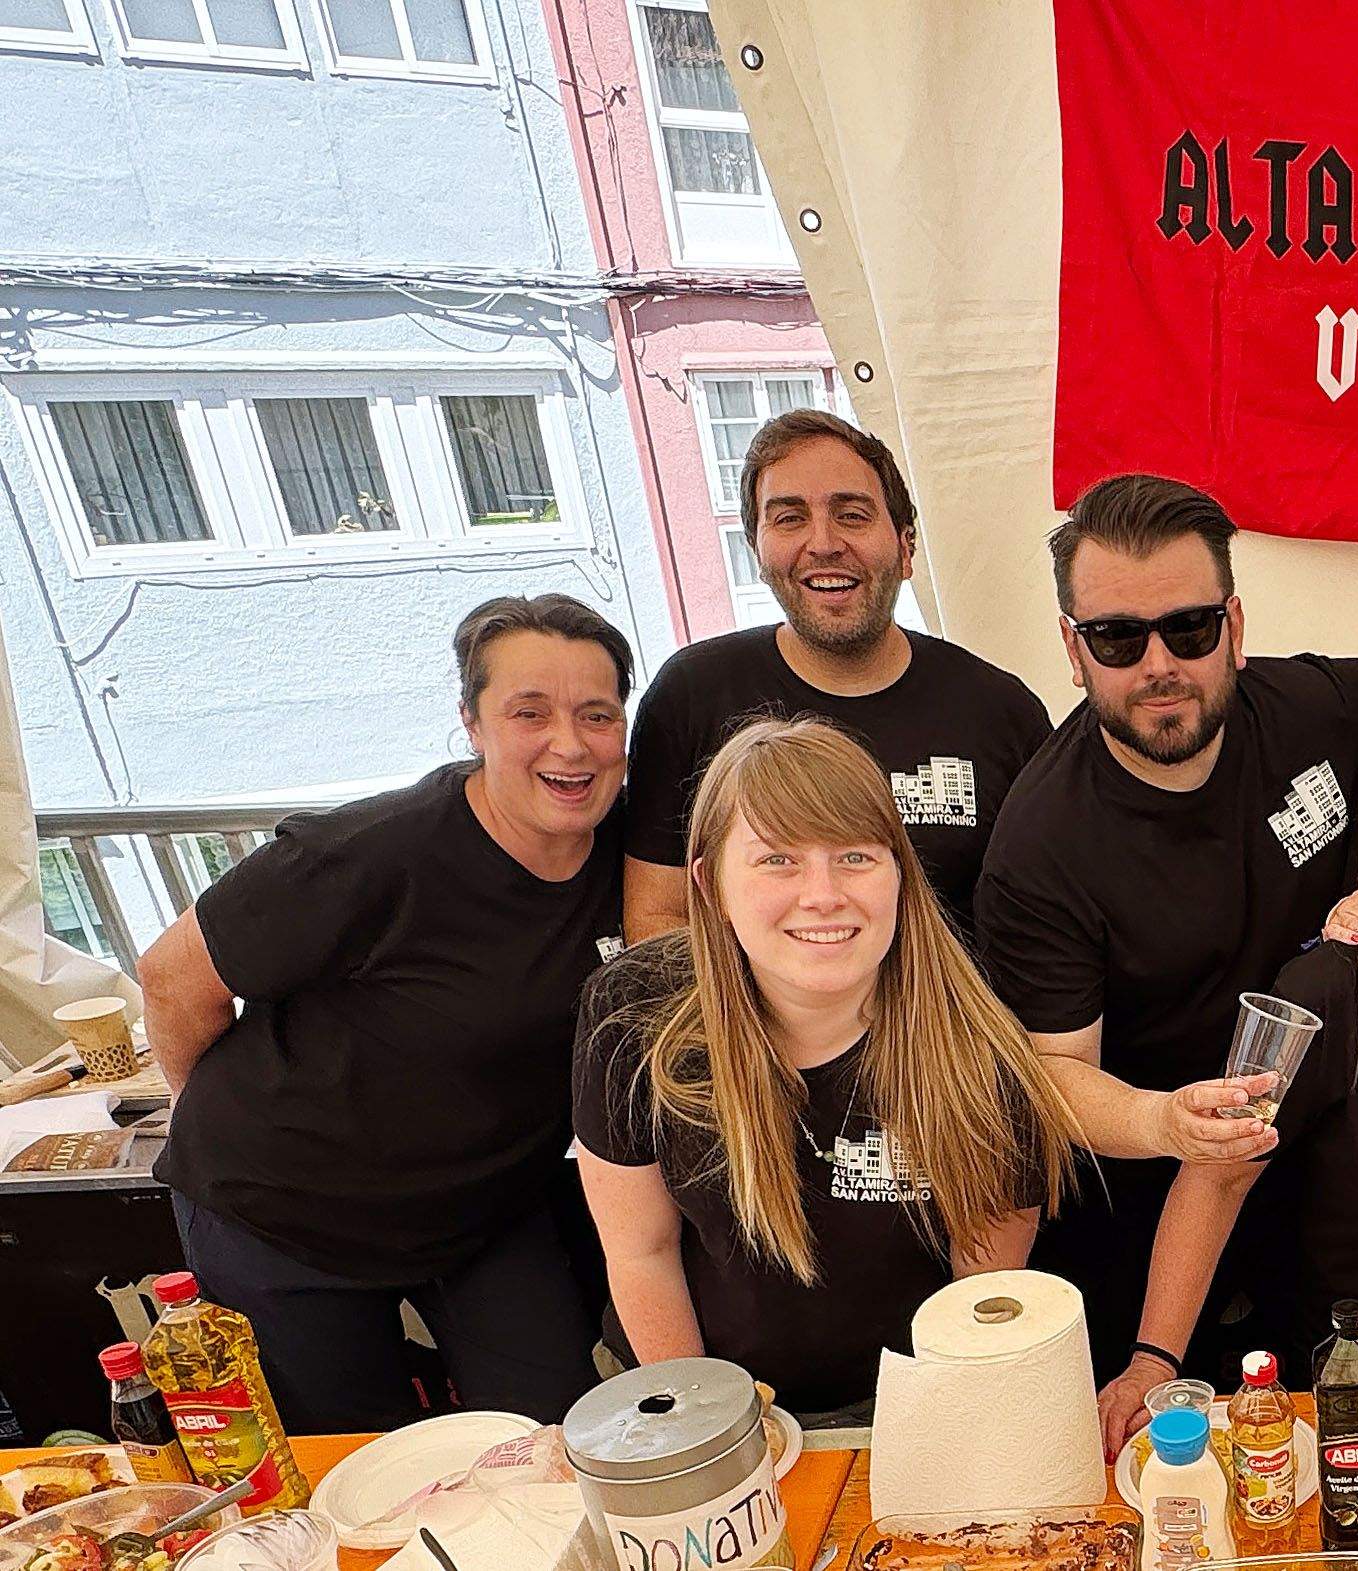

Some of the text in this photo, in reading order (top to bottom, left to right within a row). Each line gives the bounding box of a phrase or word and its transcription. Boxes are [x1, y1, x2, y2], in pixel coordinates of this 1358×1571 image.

[900, 814, 919, 824] AN
[1287, 820, 1332, 858] ALTAMIRA
[1291, 847, 1313, 868] SAN
[832, 1176, 899, 1190] ALTAMIRA
[831, 1186, 858, 1200] SAN
[176, 1415, 227, 1430] ABRIL
[1326, 1475, 1352, 1484] Aceite
[1330, 1484, 1358, 1493] Virgen
